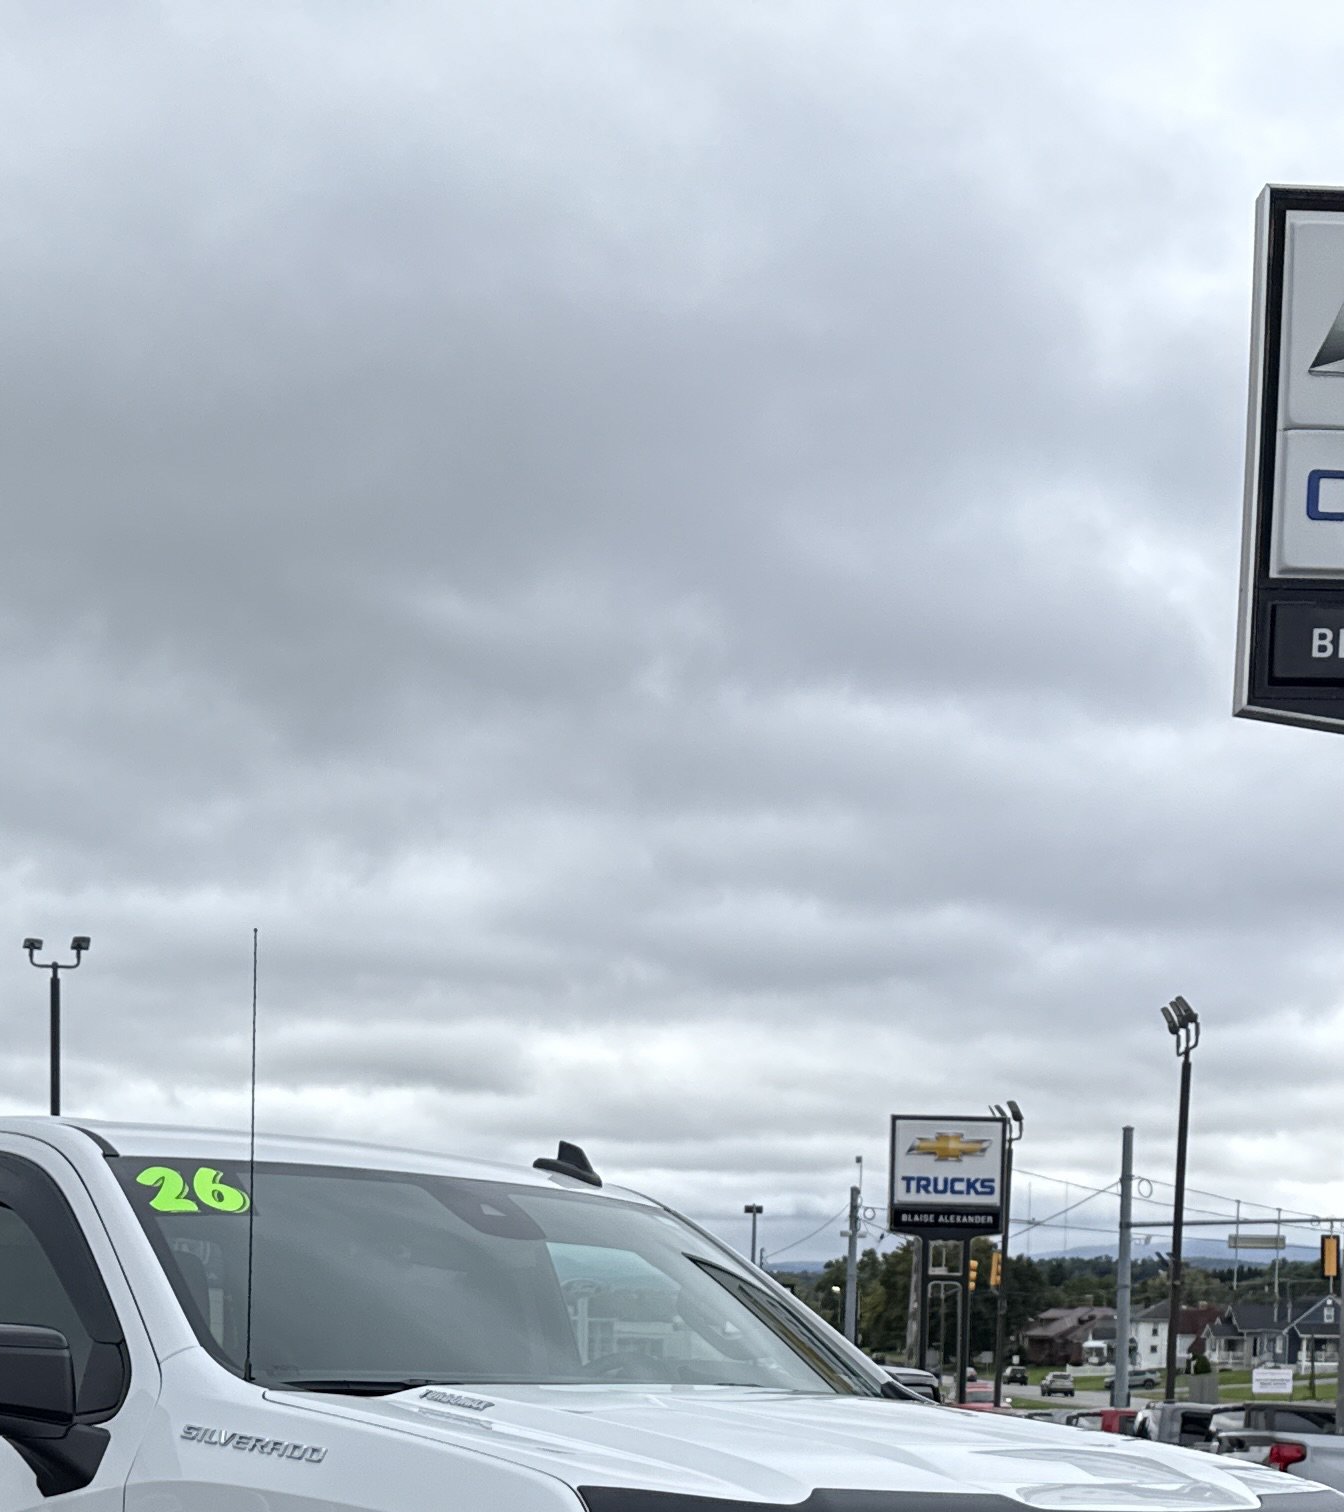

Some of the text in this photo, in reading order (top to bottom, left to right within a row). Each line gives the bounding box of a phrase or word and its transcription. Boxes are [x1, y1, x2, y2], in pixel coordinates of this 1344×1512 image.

[136, 1165, 251, 1214] 26
[901, 1175, 996, 1196] TRUCKS
[901, 1213, 994, 1224] BLAISE ALEXANDER
[180, 1423, 329, 1464] SILVERADO
